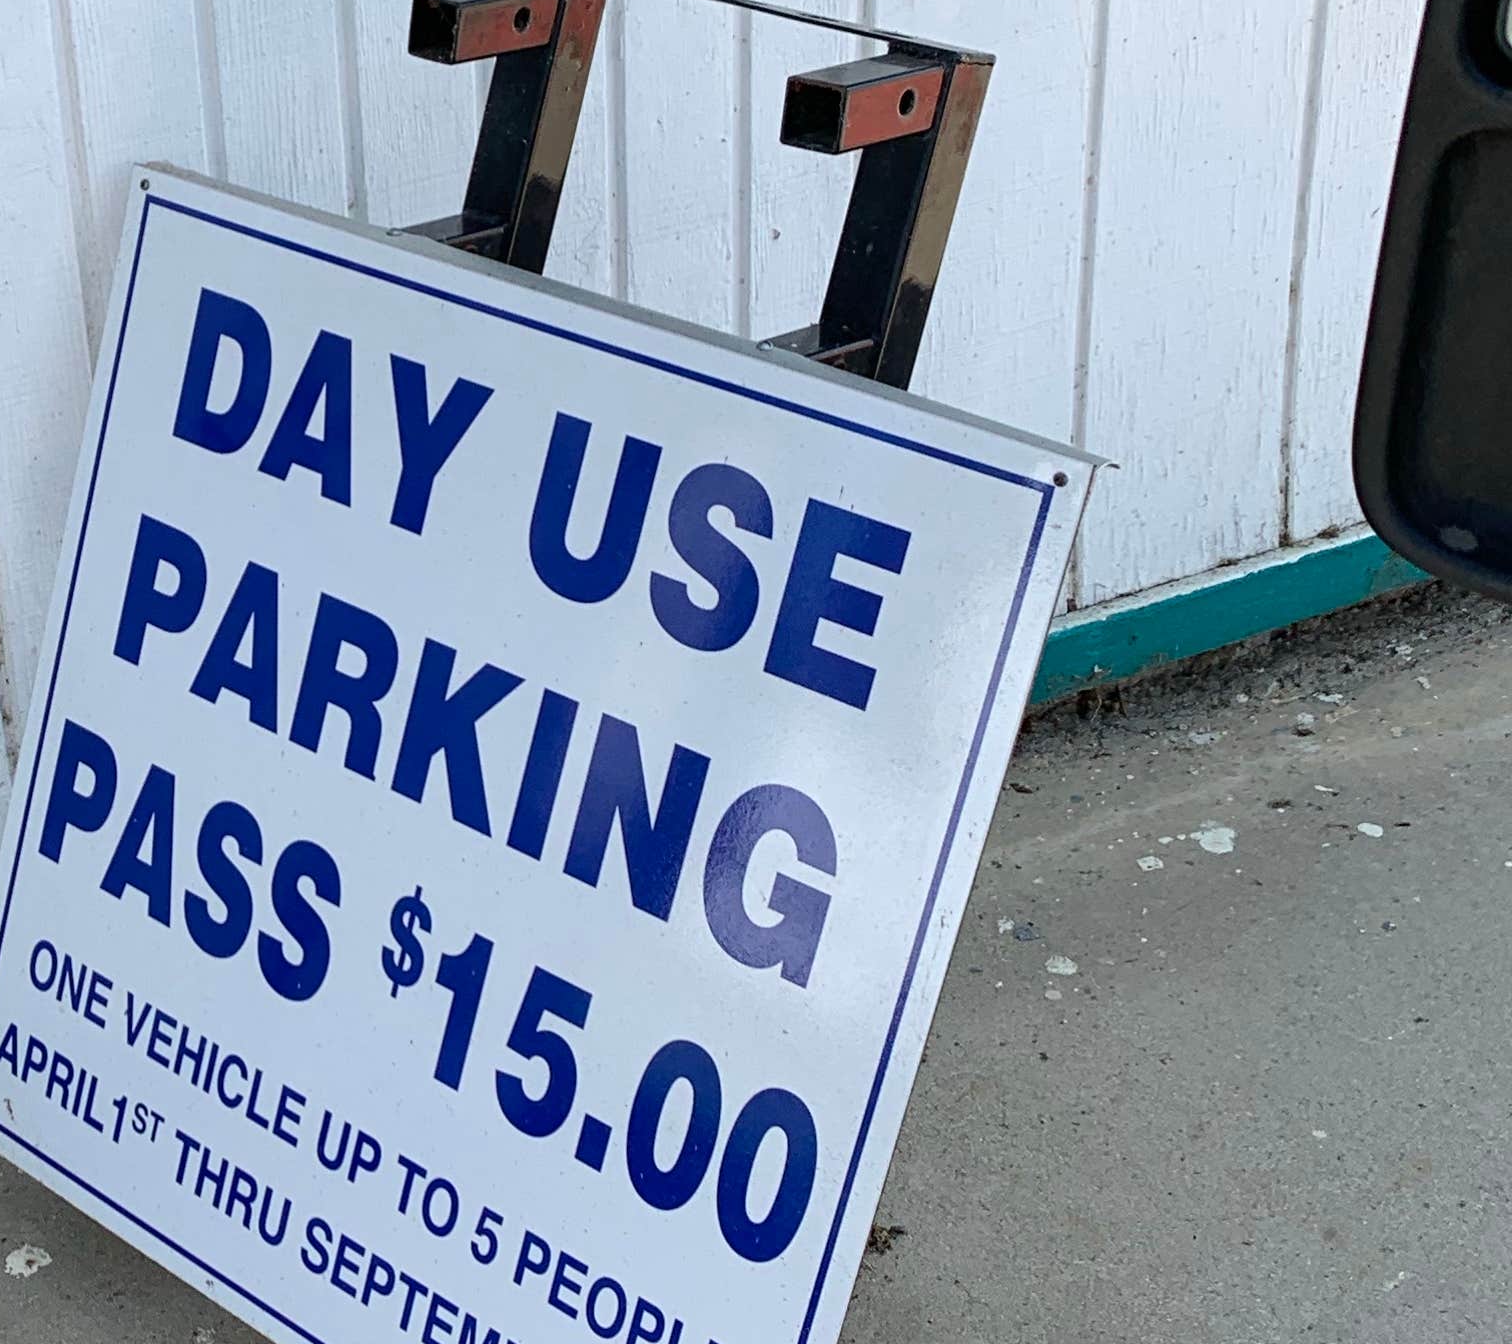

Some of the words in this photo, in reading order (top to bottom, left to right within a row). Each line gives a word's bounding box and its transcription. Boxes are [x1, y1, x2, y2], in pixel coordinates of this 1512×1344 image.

[172, 288, 494, 536] DAY
[528, 411, 911, 711] USE
[112, 513, 837, 988] PARKING
[30, 940, 112, 1028] ONE
[124, 992, 306, 1147] VEHICLE
[317, 1110, 382, 1184] UP
[397, 1154, 459, 1237] TO
[471, 1207, 502, 1265] 5
[39, 718, 341, 1002] PASS
[381, 887, 819, 1263] $15.00
[174, 1129, 292, 1246] THRU
